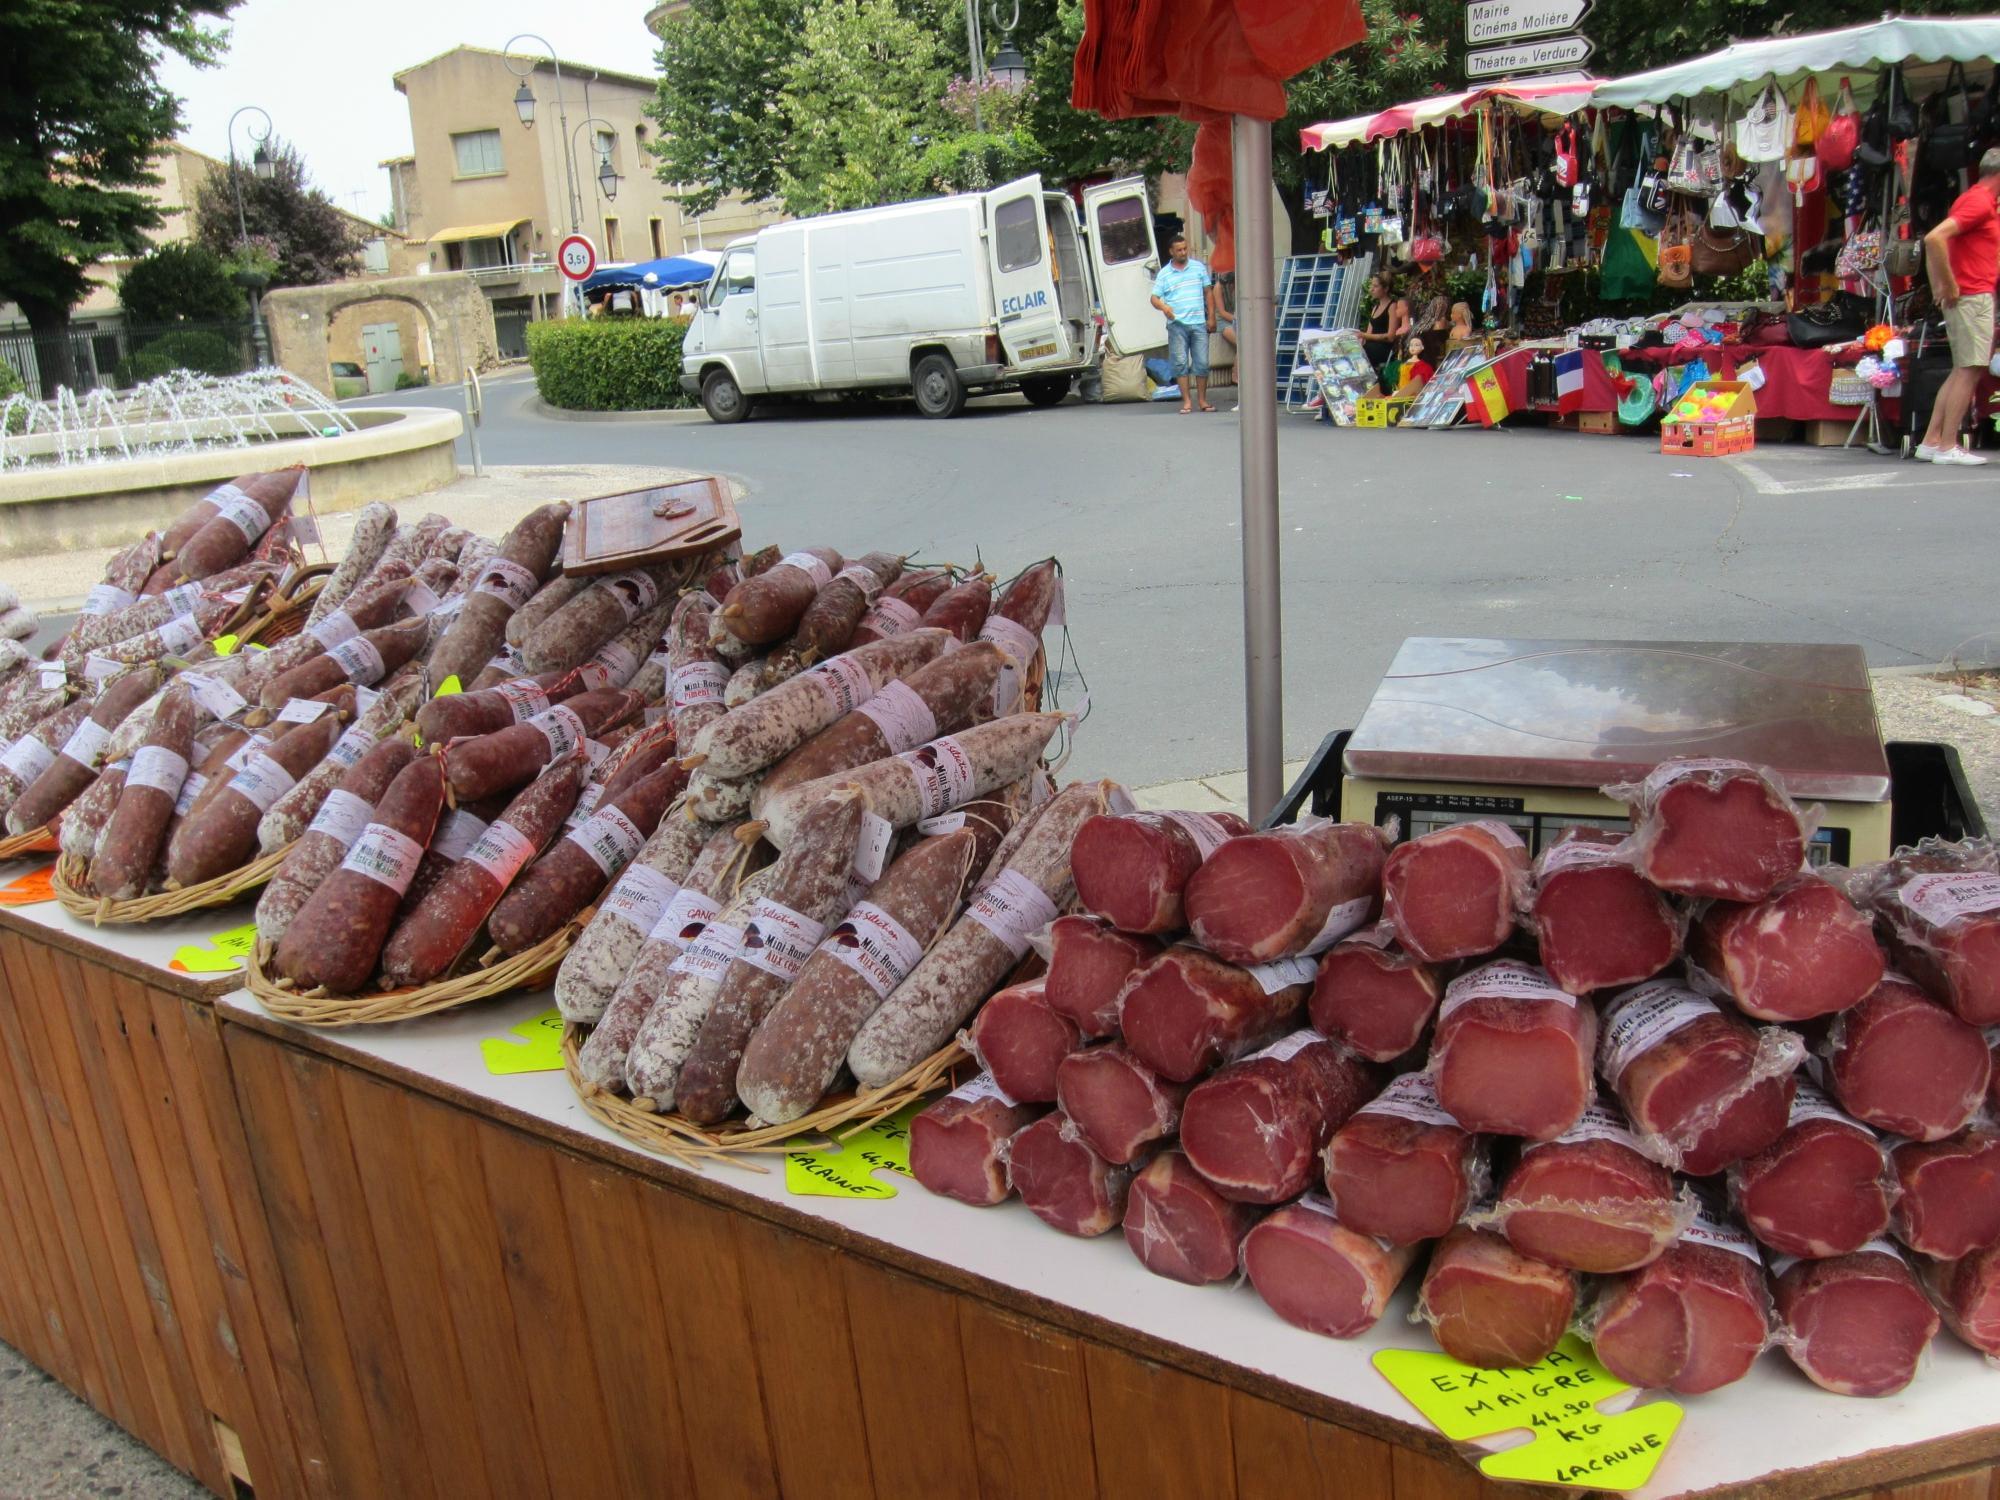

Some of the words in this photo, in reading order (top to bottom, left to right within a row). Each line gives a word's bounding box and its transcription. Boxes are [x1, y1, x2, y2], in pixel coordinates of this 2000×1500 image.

[1472, 6, 1510, 21] Mairie
[1473, 20, 1517, 37] Cinéma
[1522, 12, 1569, 29] Molière
[1519, 55, 1528, 64] de
[1532, 45, 1578, 62] Verdure
[567, 253, 586, 266] 3,5t
[1002, 290, 1047, 315] ECLAIR
[762, 906, 801, 930] Selection
[864, 911, 899, 941] Selection
[765, 950, 782, 967] Aux
[857, 952, 875, 970] Aux
[1530, 1399, 1591, 1427] 44.90
[1556, 1433, 1664, 1483] LACAUNE
